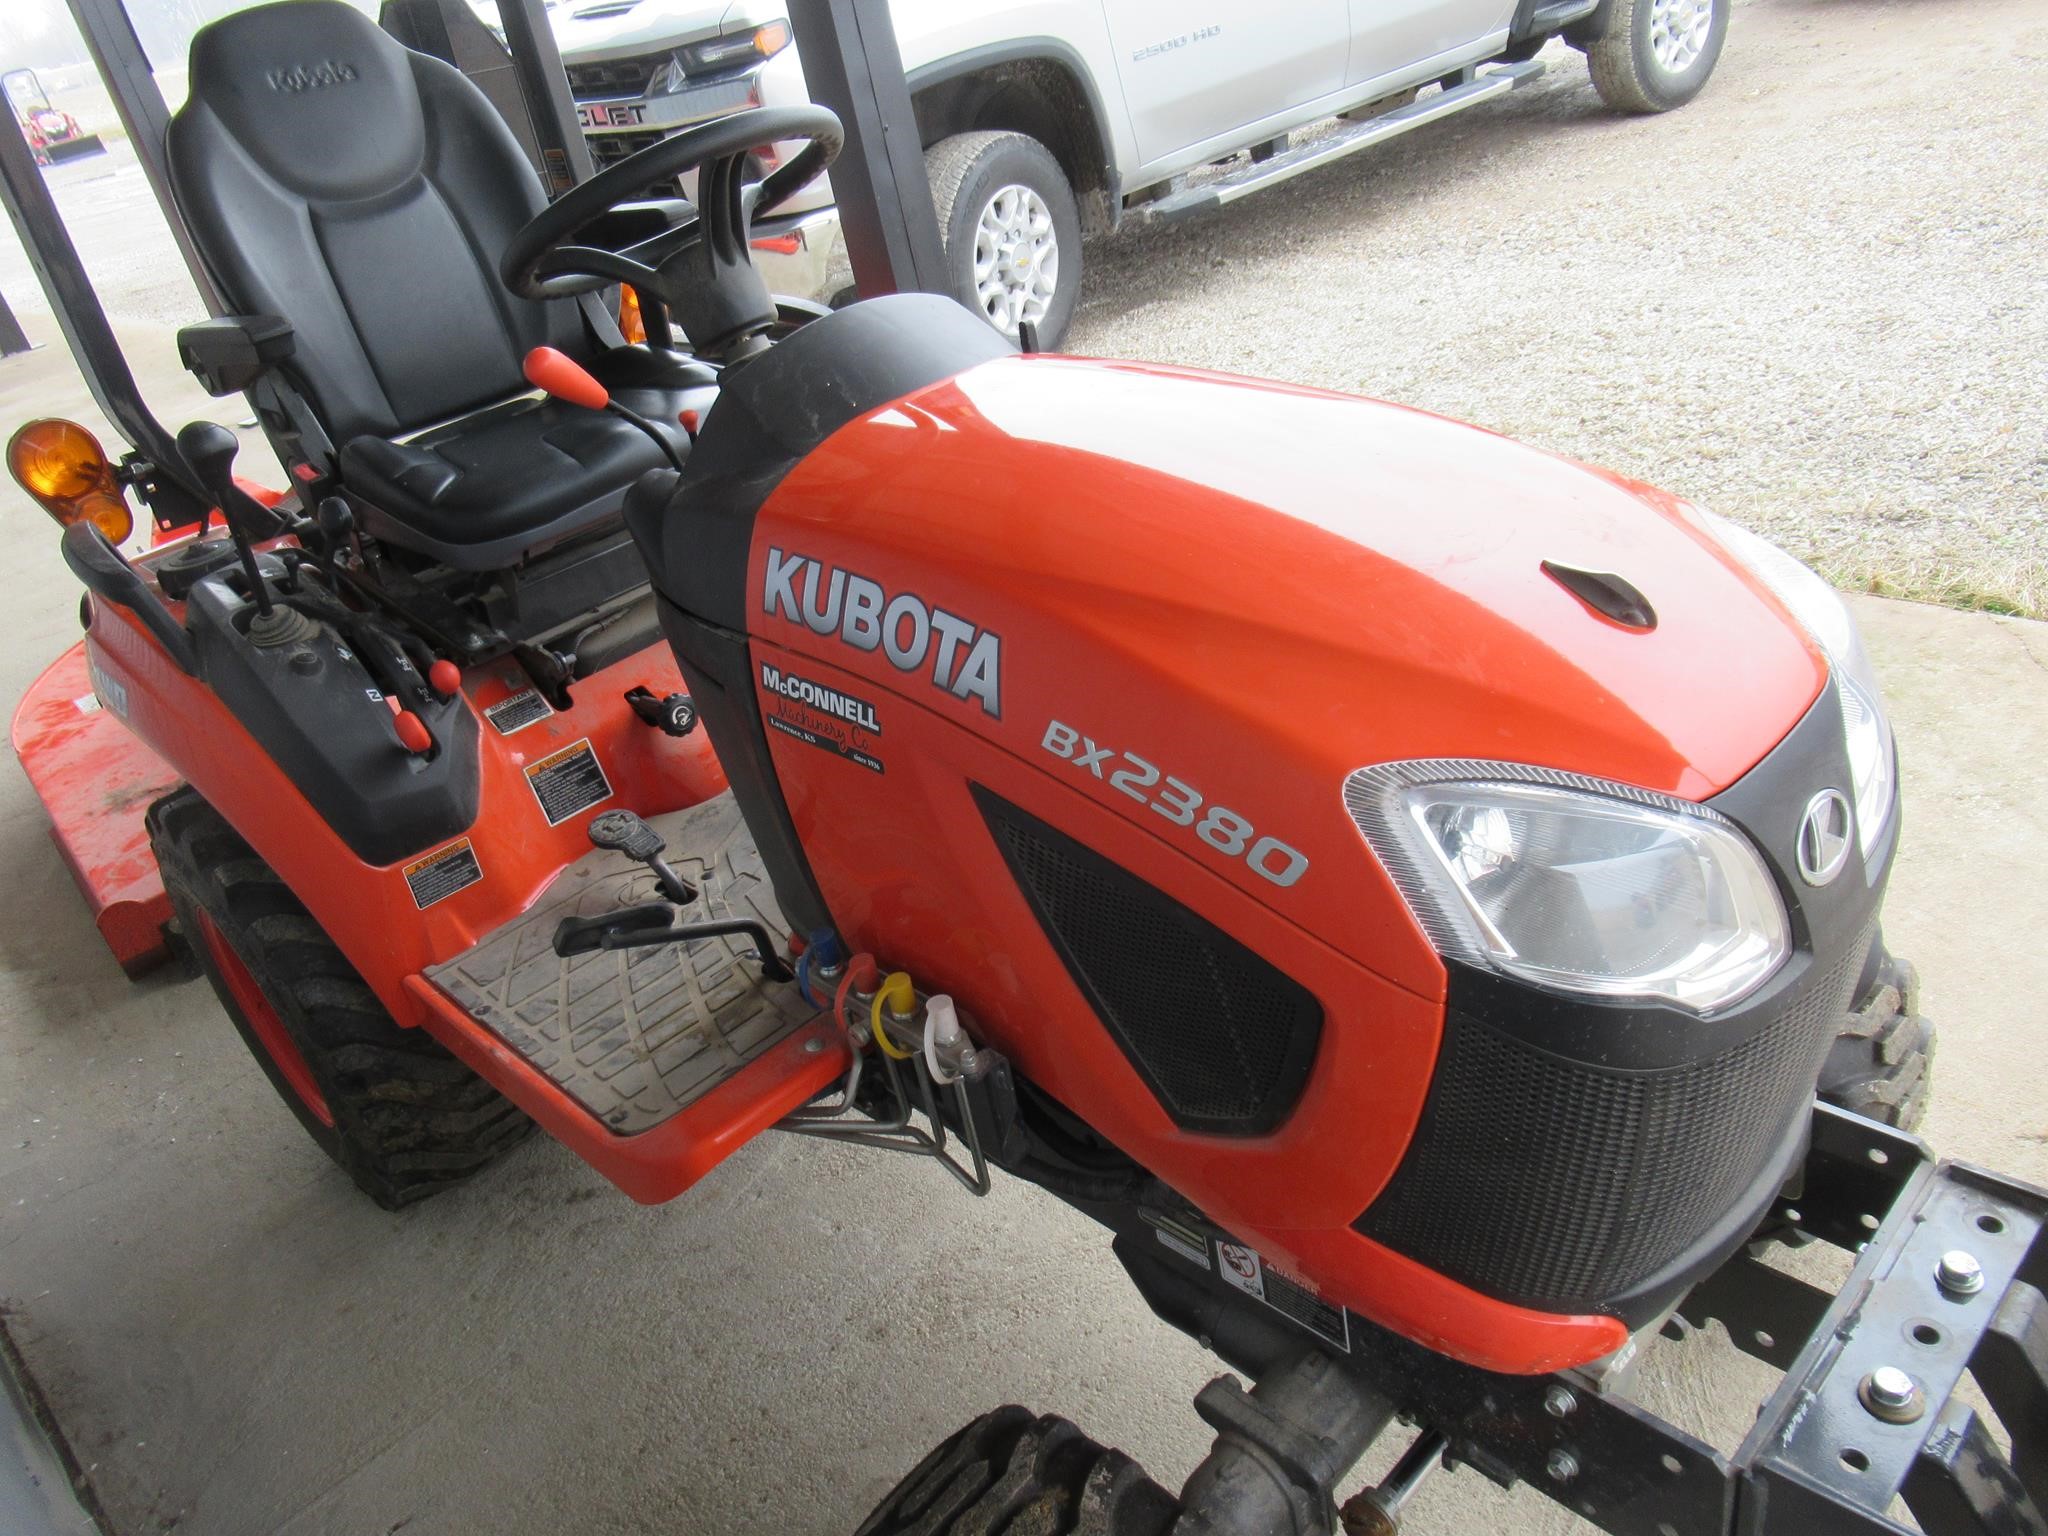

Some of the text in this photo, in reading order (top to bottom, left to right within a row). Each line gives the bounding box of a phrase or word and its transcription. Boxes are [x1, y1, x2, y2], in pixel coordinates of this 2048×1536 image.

[1132, 24, 1221, 61] 2500 HD
[762, 546, 1001, 718] KUBOTA
[762, 665, 880, 732] McCONNELL
[1041, 719, 1309, 887] BX2380
